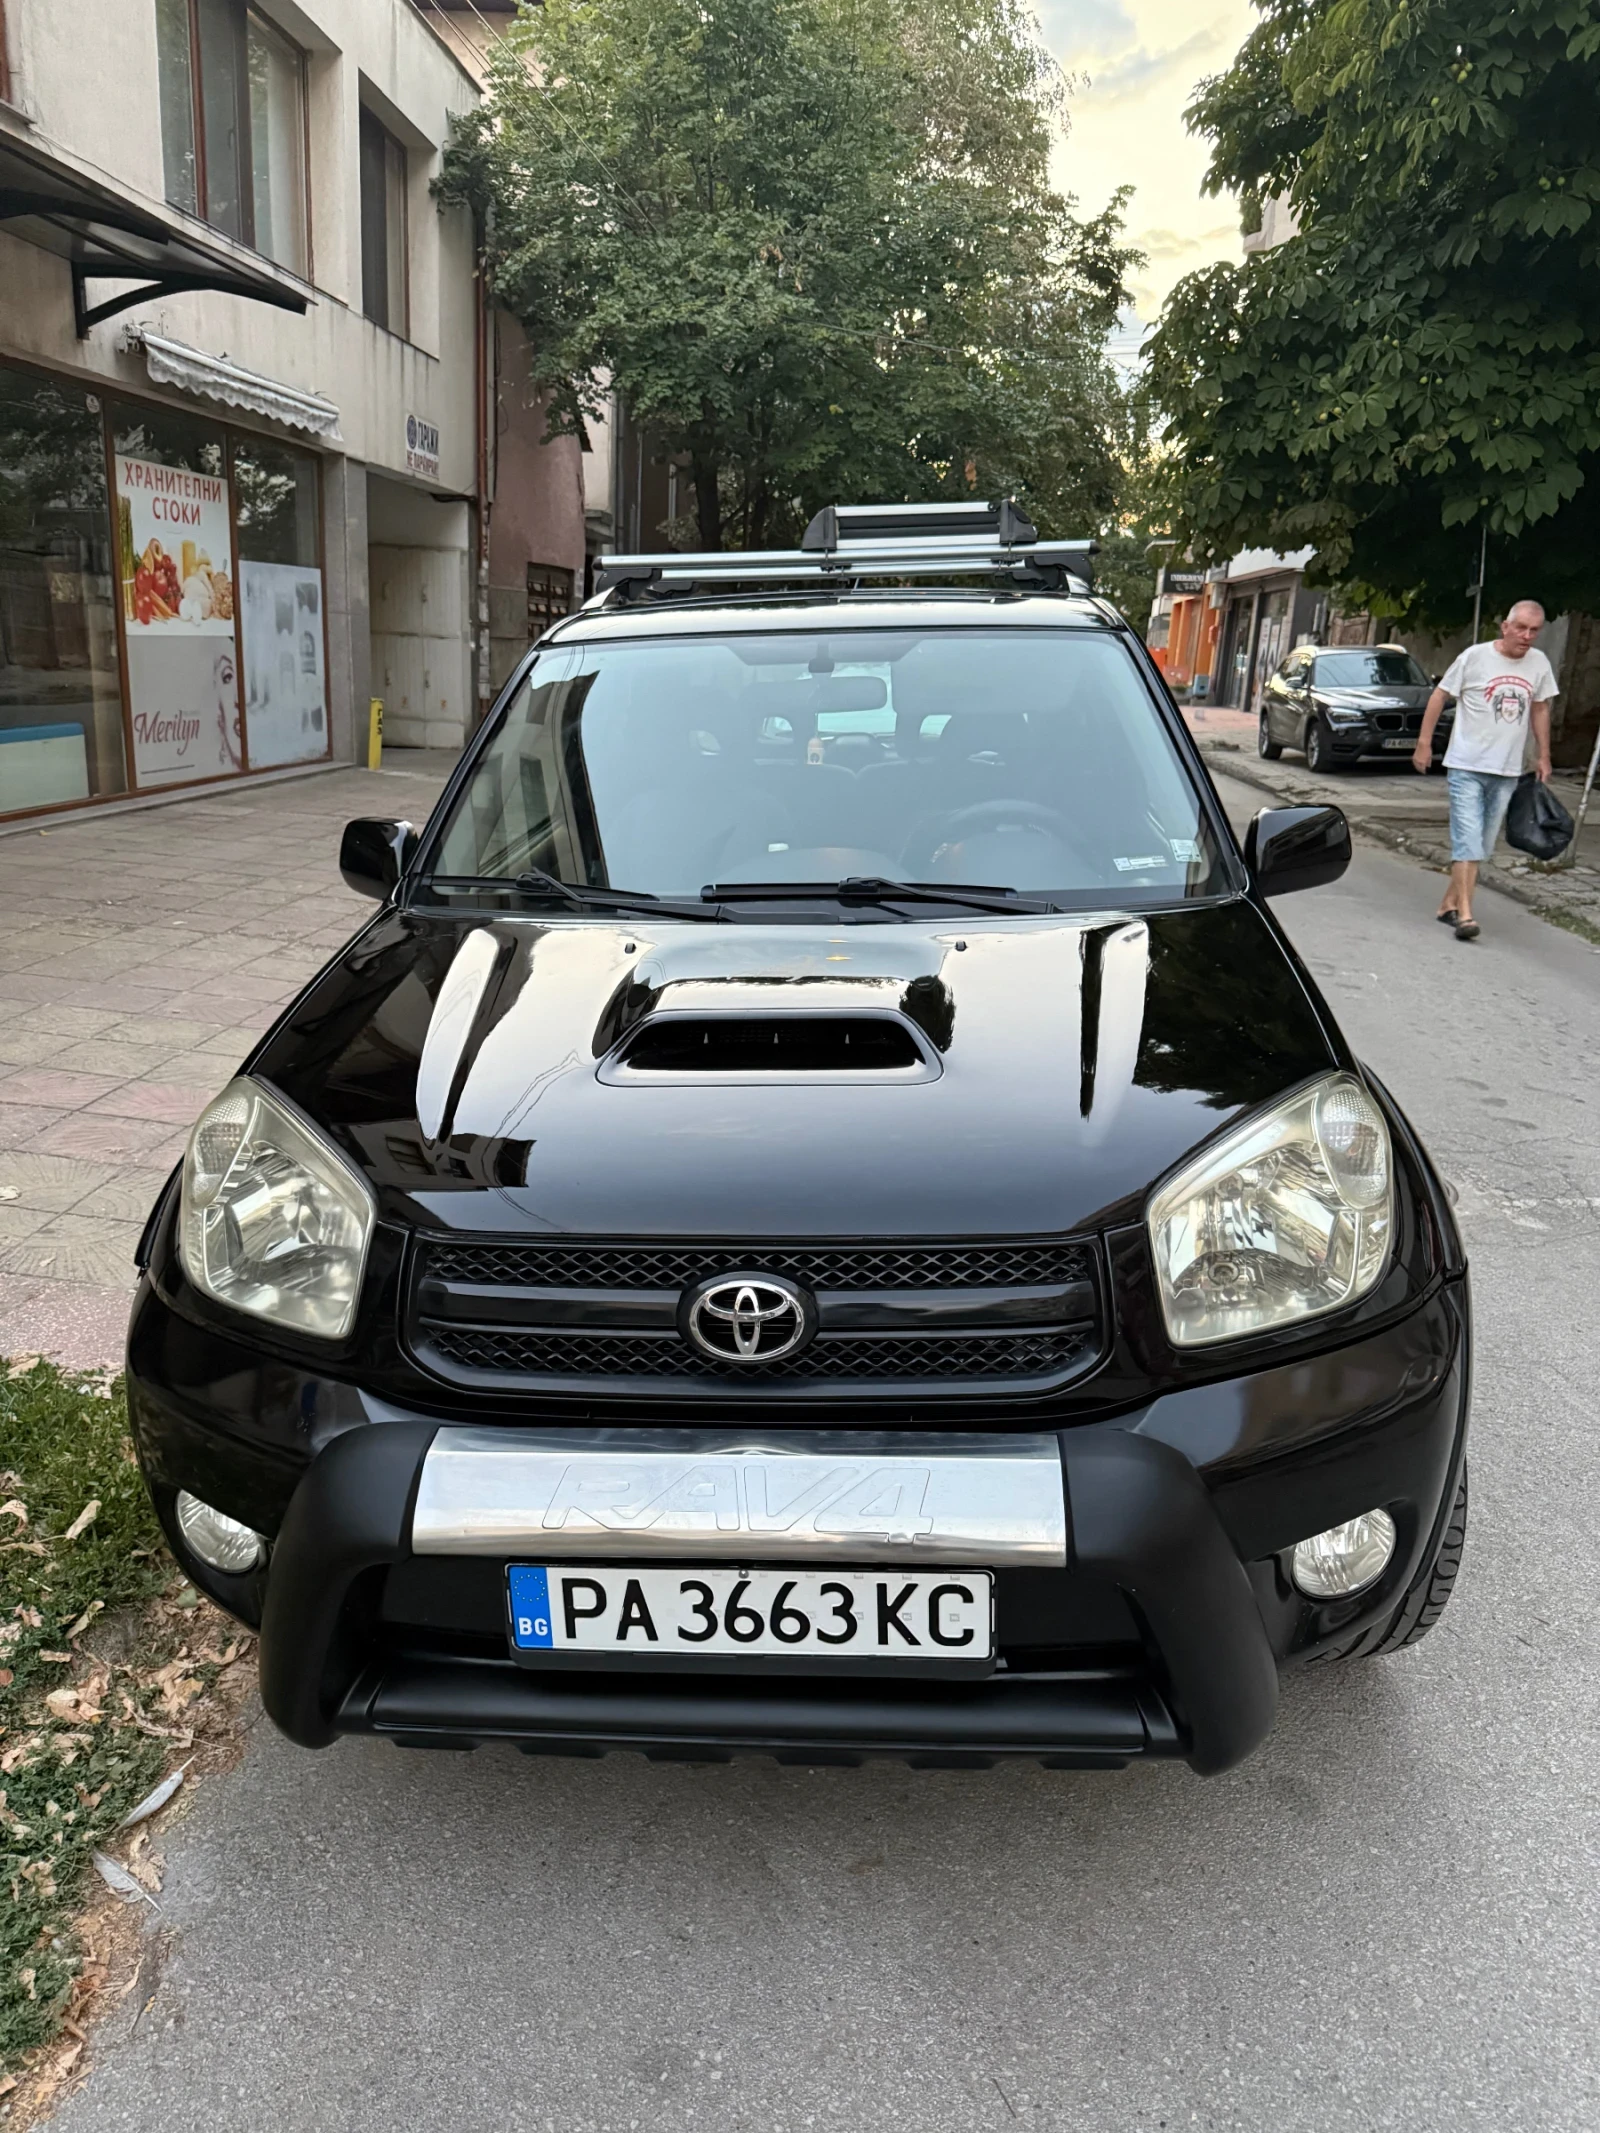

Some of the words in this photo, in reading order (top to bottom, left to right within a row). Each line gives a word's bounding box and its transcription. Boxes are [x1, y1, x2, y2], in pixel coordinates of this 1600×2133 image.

[124, 461, 222, 503] ХРАНИТЕЛНИ
[152, 496, 201, 526] СТОКИ
[134, 709, 200, 756] Merilyn
[541, 1464, 935, 1544] RAV4
[518, 1618, 549, 1637] BG
[561, 1577, 659, 1642] PA
[677, 1579, 858, 1644] 3663
[876, 1582, 975, 1647] KC
